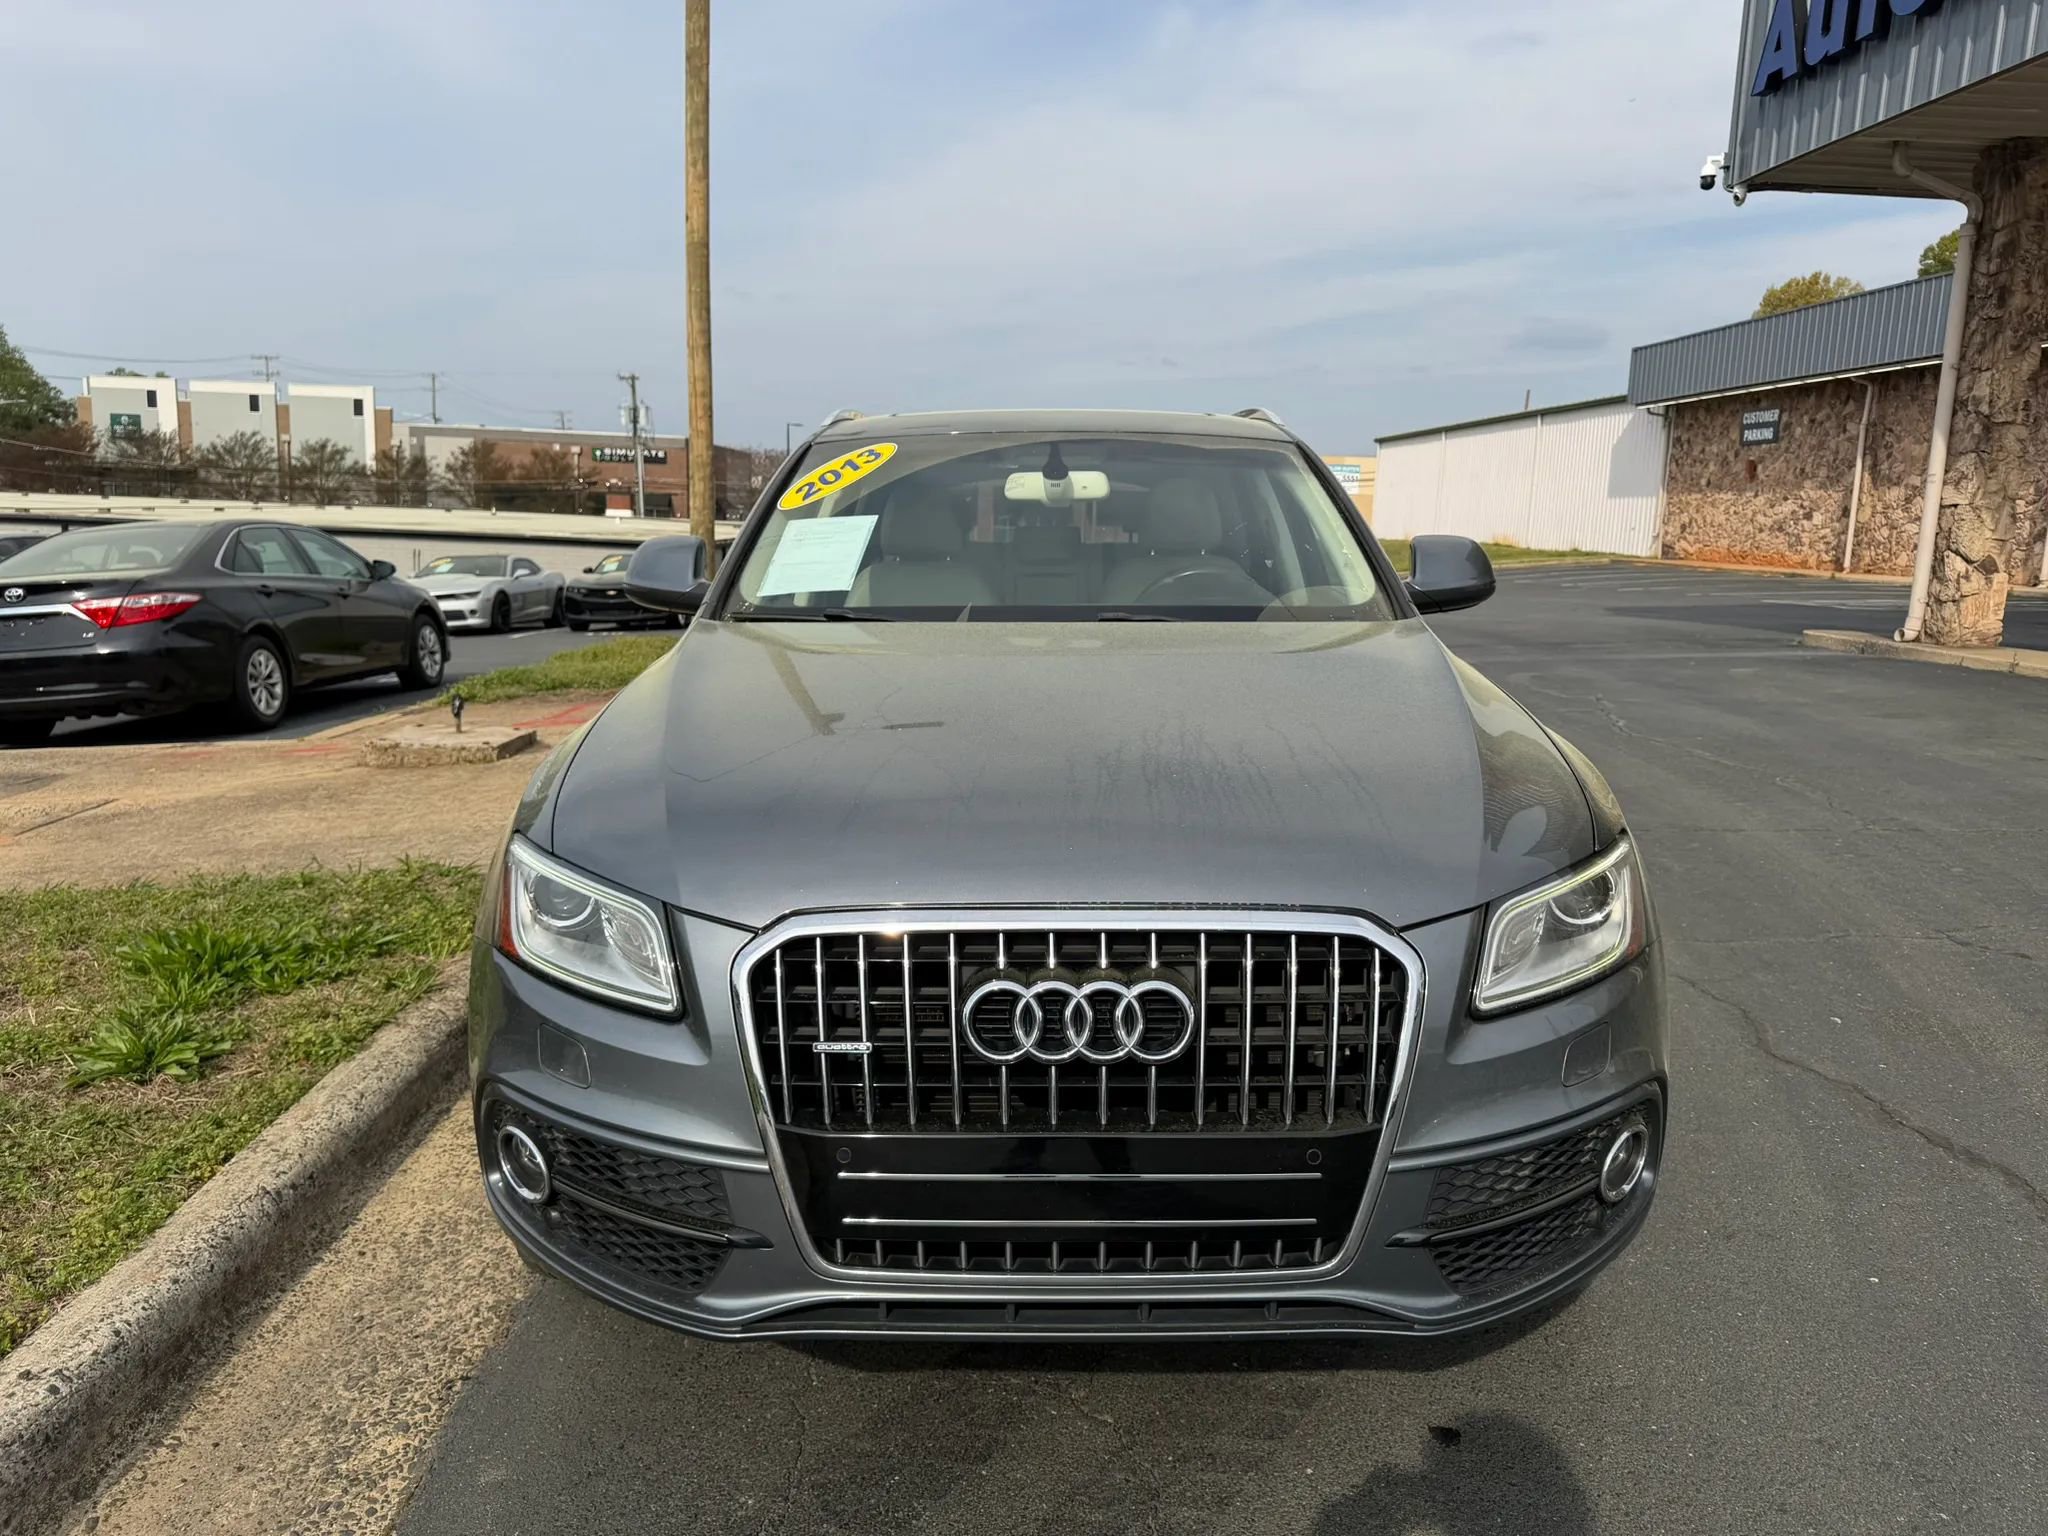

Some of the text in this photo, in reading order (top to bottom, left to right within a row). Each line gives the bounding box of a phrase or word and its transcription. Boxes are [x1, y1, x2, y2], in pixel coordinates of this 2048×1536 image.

[1752, 0, 1932, 96] Au
[1743, 409, 1780, 424] CUSTOMER
[1743, 427, 1774, 441] PARKING
[603, 447, 665, 458] SIMUATE
[795, 449, 882, 501] 2013
[815, 1043, 868, 1051] quattro
